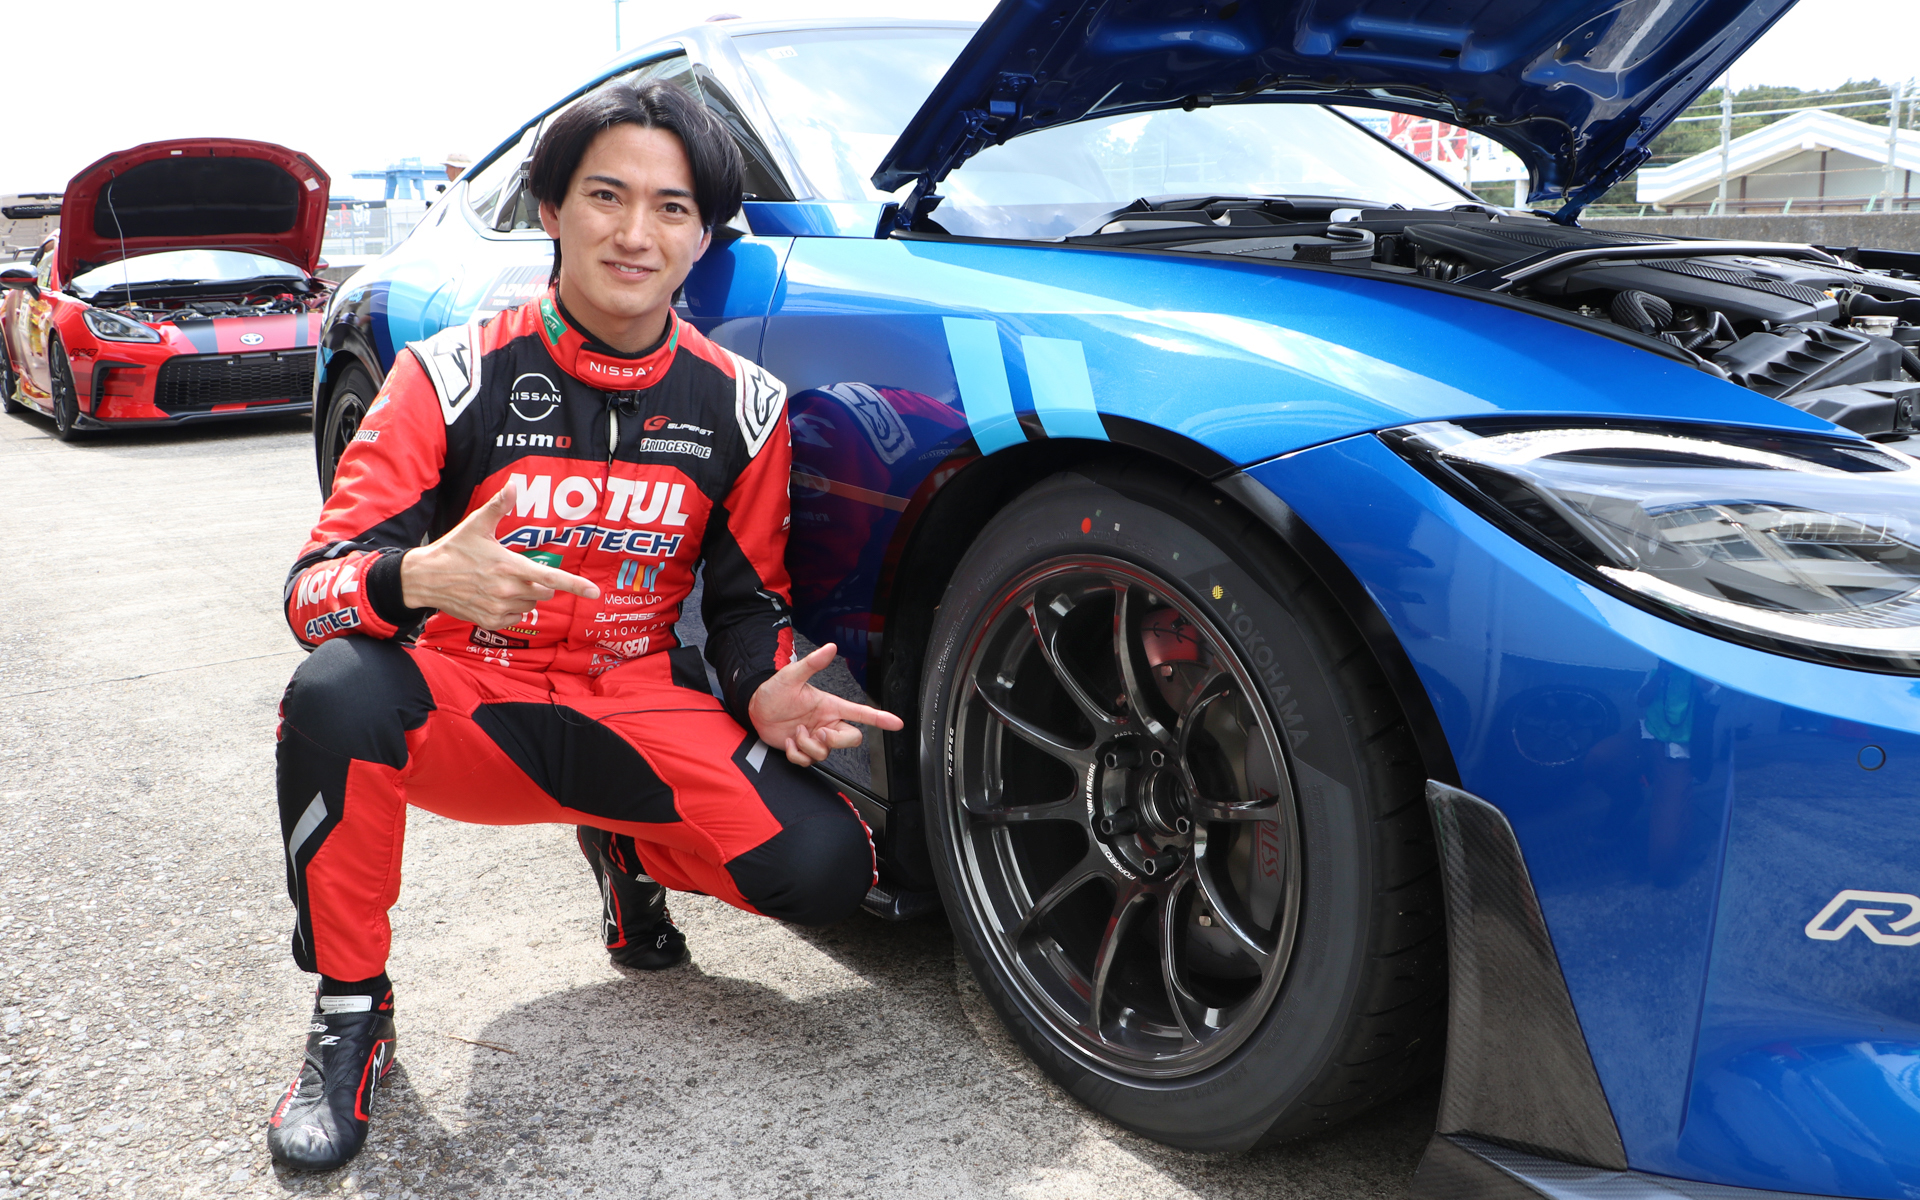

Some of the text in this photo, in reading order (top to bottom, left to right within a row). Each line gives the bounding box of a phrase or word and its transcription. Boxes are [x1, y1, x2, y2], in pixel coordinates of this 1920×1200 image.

[491, 283, 549, 297] ADVAN
[505, 472, 690, 527] MOTUL
[498, 524, 685, 557] AUTECH
[604, 593, 643, 605] Media
[585, 621, 666, 638] VISIONARY
[1226, 604, 1310, 750] YOKOHAMA
[1086, 762, 1096, 792] RACING
[1260, 787, 1280, 882] DLESS
[1104, 850, 1137, 881] FORGED
